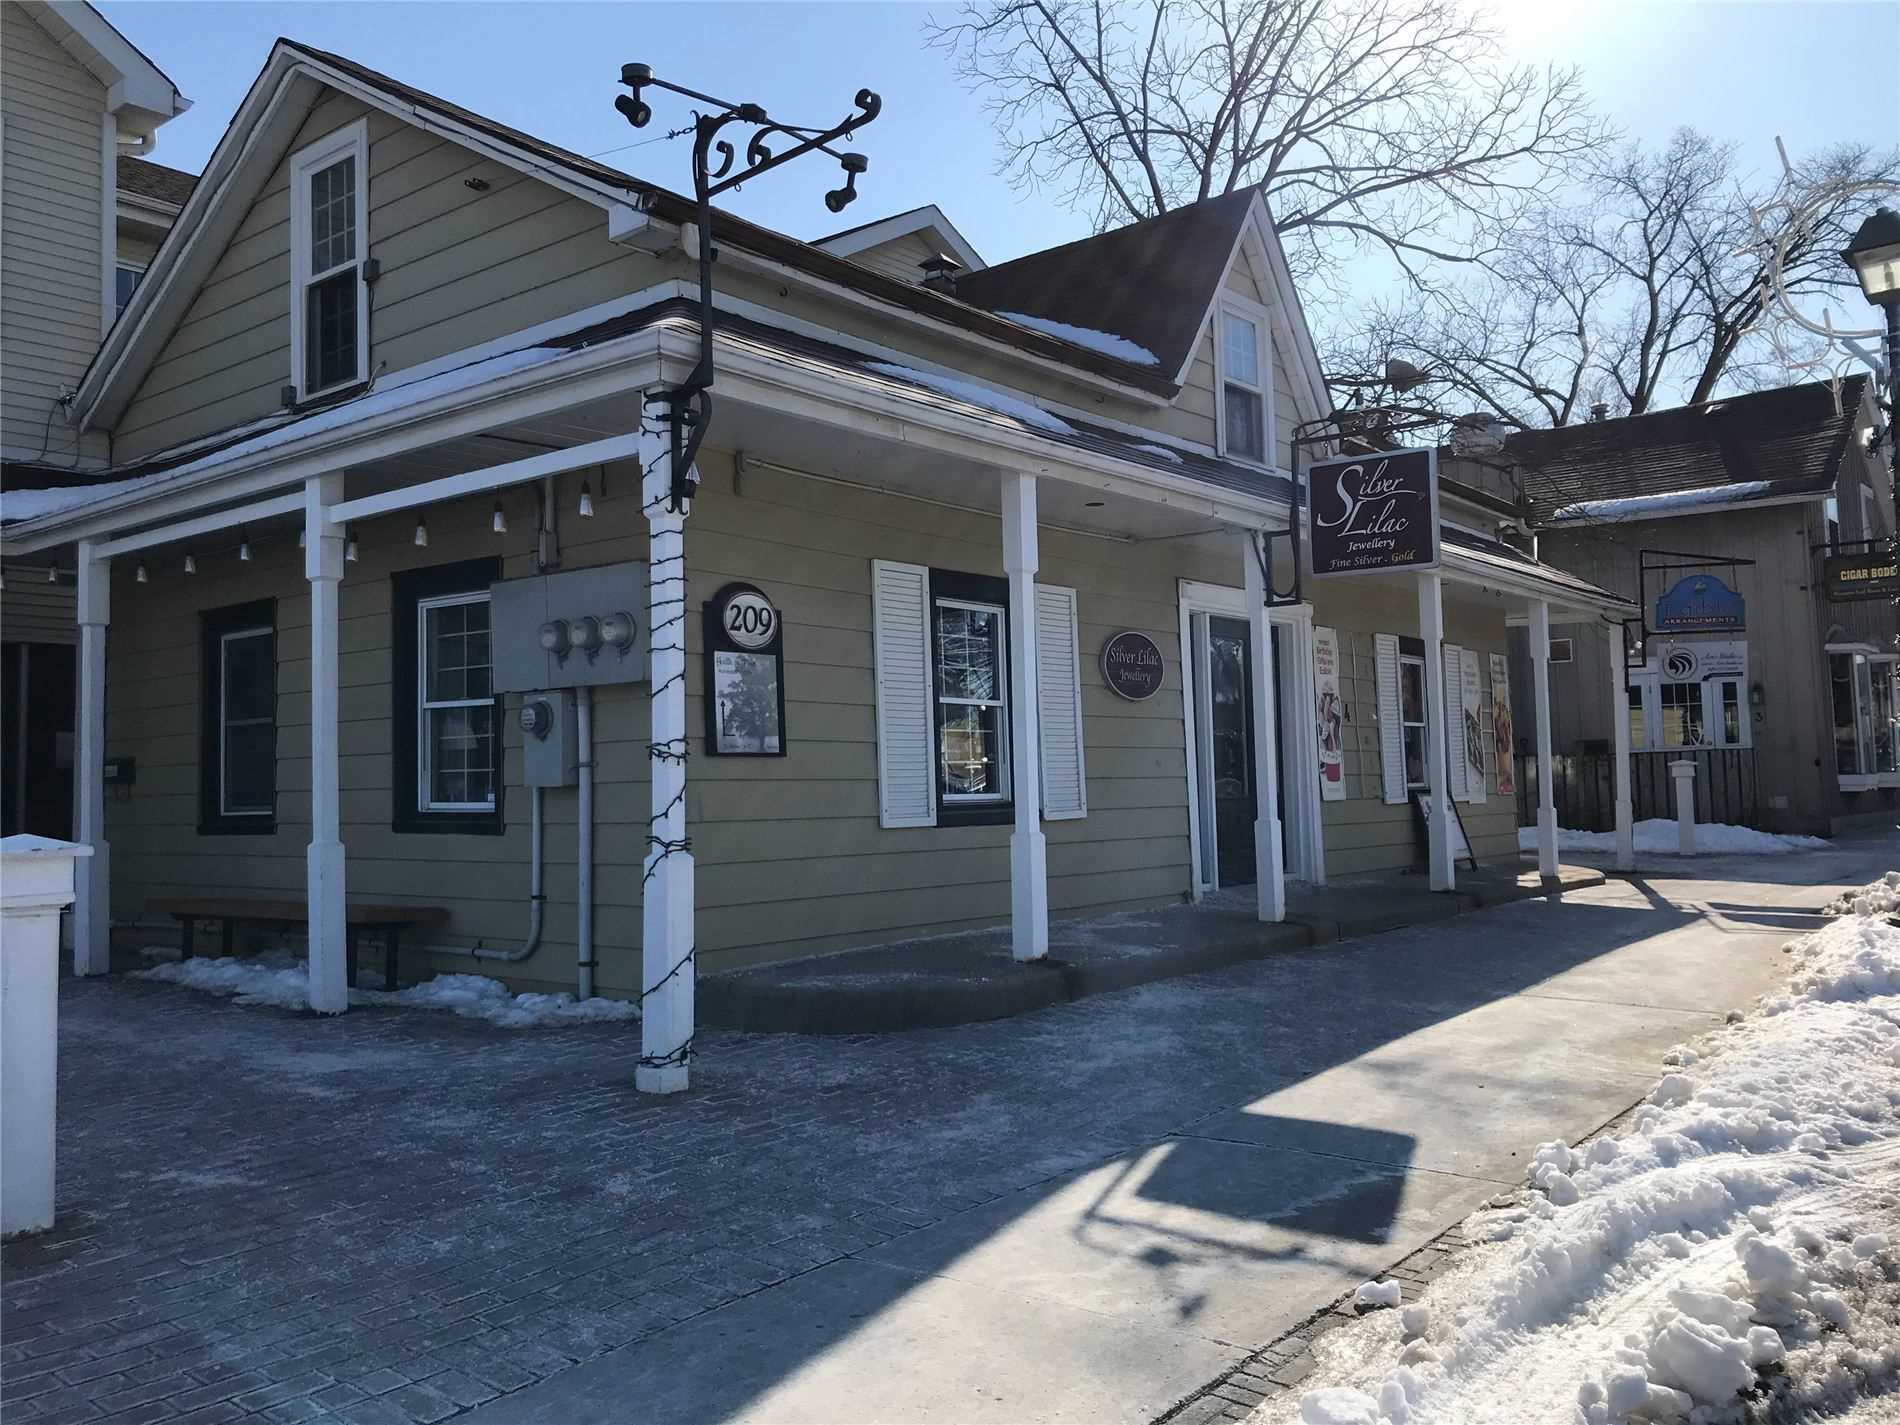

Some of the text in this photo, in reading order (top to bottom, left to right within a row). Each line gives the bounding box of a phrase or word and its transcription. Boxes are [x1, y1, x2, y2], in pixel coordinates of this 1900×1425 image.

[1317, 459, 1404, 527] Silver
[1337, 499, 1409, 537] Lilac
[1347, 538, 1396, 552] Jewellery
[1329, 559, 1351, 570] Fine
[1354, 555, 1383, 567] Silver
[1391, 550, 1416, 562] Gold
[1840, 569, 1869, 581] CIGAR
[729, 604, 772, 636] 209
[1109, 646, 1159, 666] Silver Lilac
